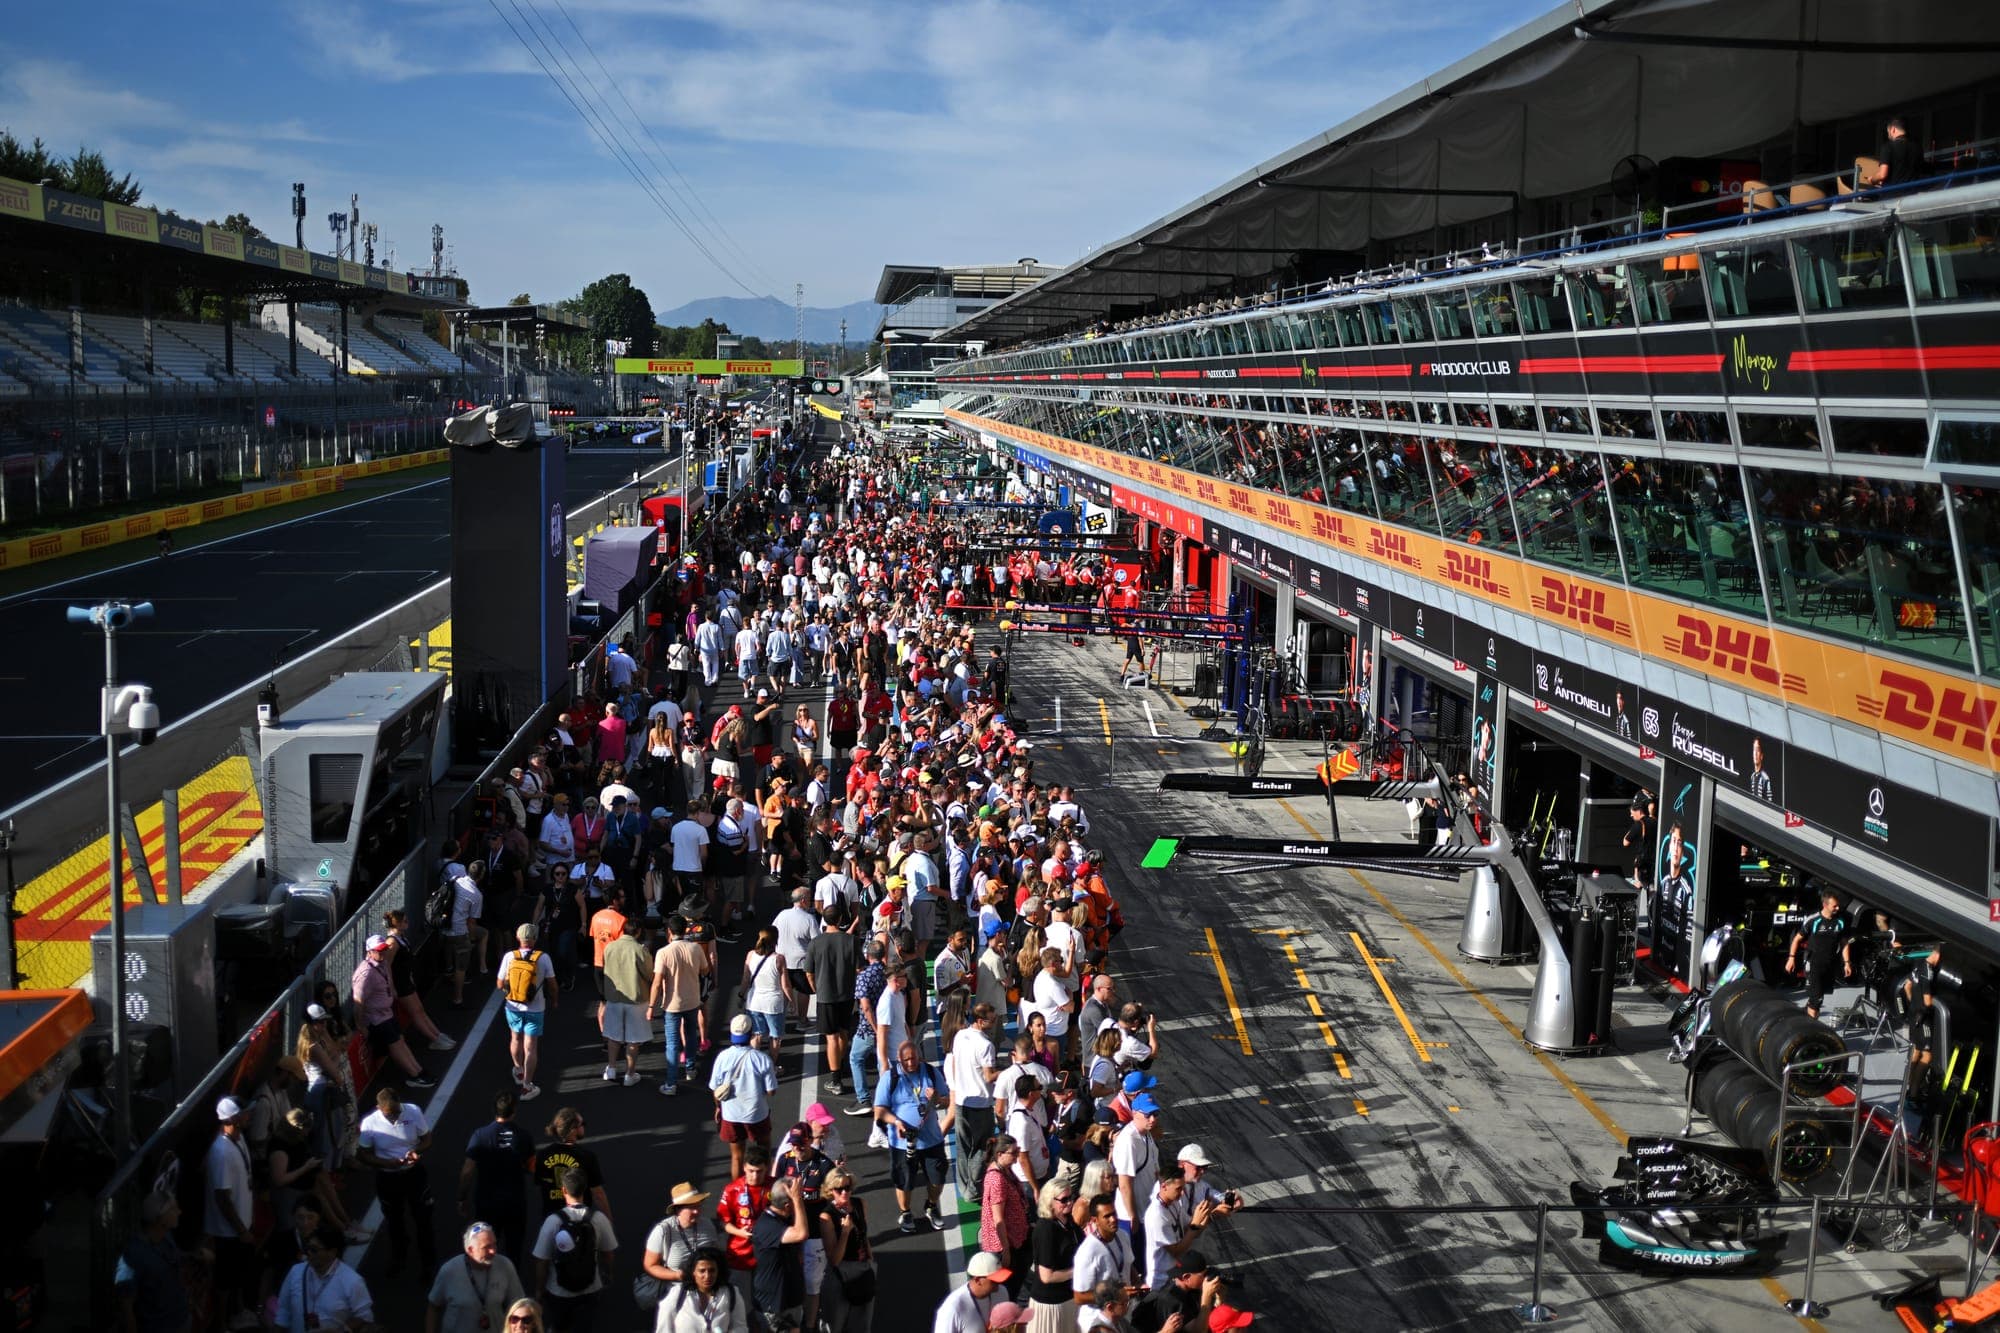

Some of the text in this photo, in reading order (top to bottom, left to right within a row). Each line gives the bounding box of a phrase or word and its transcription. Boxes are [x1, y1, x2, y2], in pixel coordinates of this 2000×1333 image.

[47, 198, 101, 222] P ZERO
[115, 209, 148, 236] PIRELLI
[160, 223, 201, 244] P ZERO
[211, 232, 236, 255] PIRELLI
[254, 245, 277, 260] ZERO
[318, 260, 338, 273] ZERO
[648, 360, 694, 372] PIRELLI
[726, 361, 772, 373] PIRELLI
[1733, 334, 1778, 391] Monza
[1229, 488, 1254, 513] DHL
[164, 508, 189, 527] PIRELLI
[1267, 499, 1297, 528] DHL
[81, 524, 110, 548] PIRELLI
[125, 515, 152, 537] PIRELLI
[1314, 512, 1348, 545] DHL
[29, 534, 62, 560] PIRELLI
[1370, 527, 1413, 565] DHL
[1444, 549, 1499, 594] DHL
[1542, 576, 1615, 632] DHL
[1677, 614, 1780, 686] DHL
[1536, 664, 1549, 691] 12
[1555, 685, 1611, 718] ANTONELLI
[1880, 670, 2000, 757] DH
[1642, 706, 1660, 738] 63
[1672, 735, 1740, 776] RUSSELL
[1252, 782, 1292, 790] Einhell
[1788, 811, 1801, 824] 14
[1283, 845, 1329, 854] Einhell
[544, 1153, 580, 1169] SERVING
[1637, 1145, 1665, 1155] crosoft
[1633, 1250, 1713, 1266] PETRONAS
